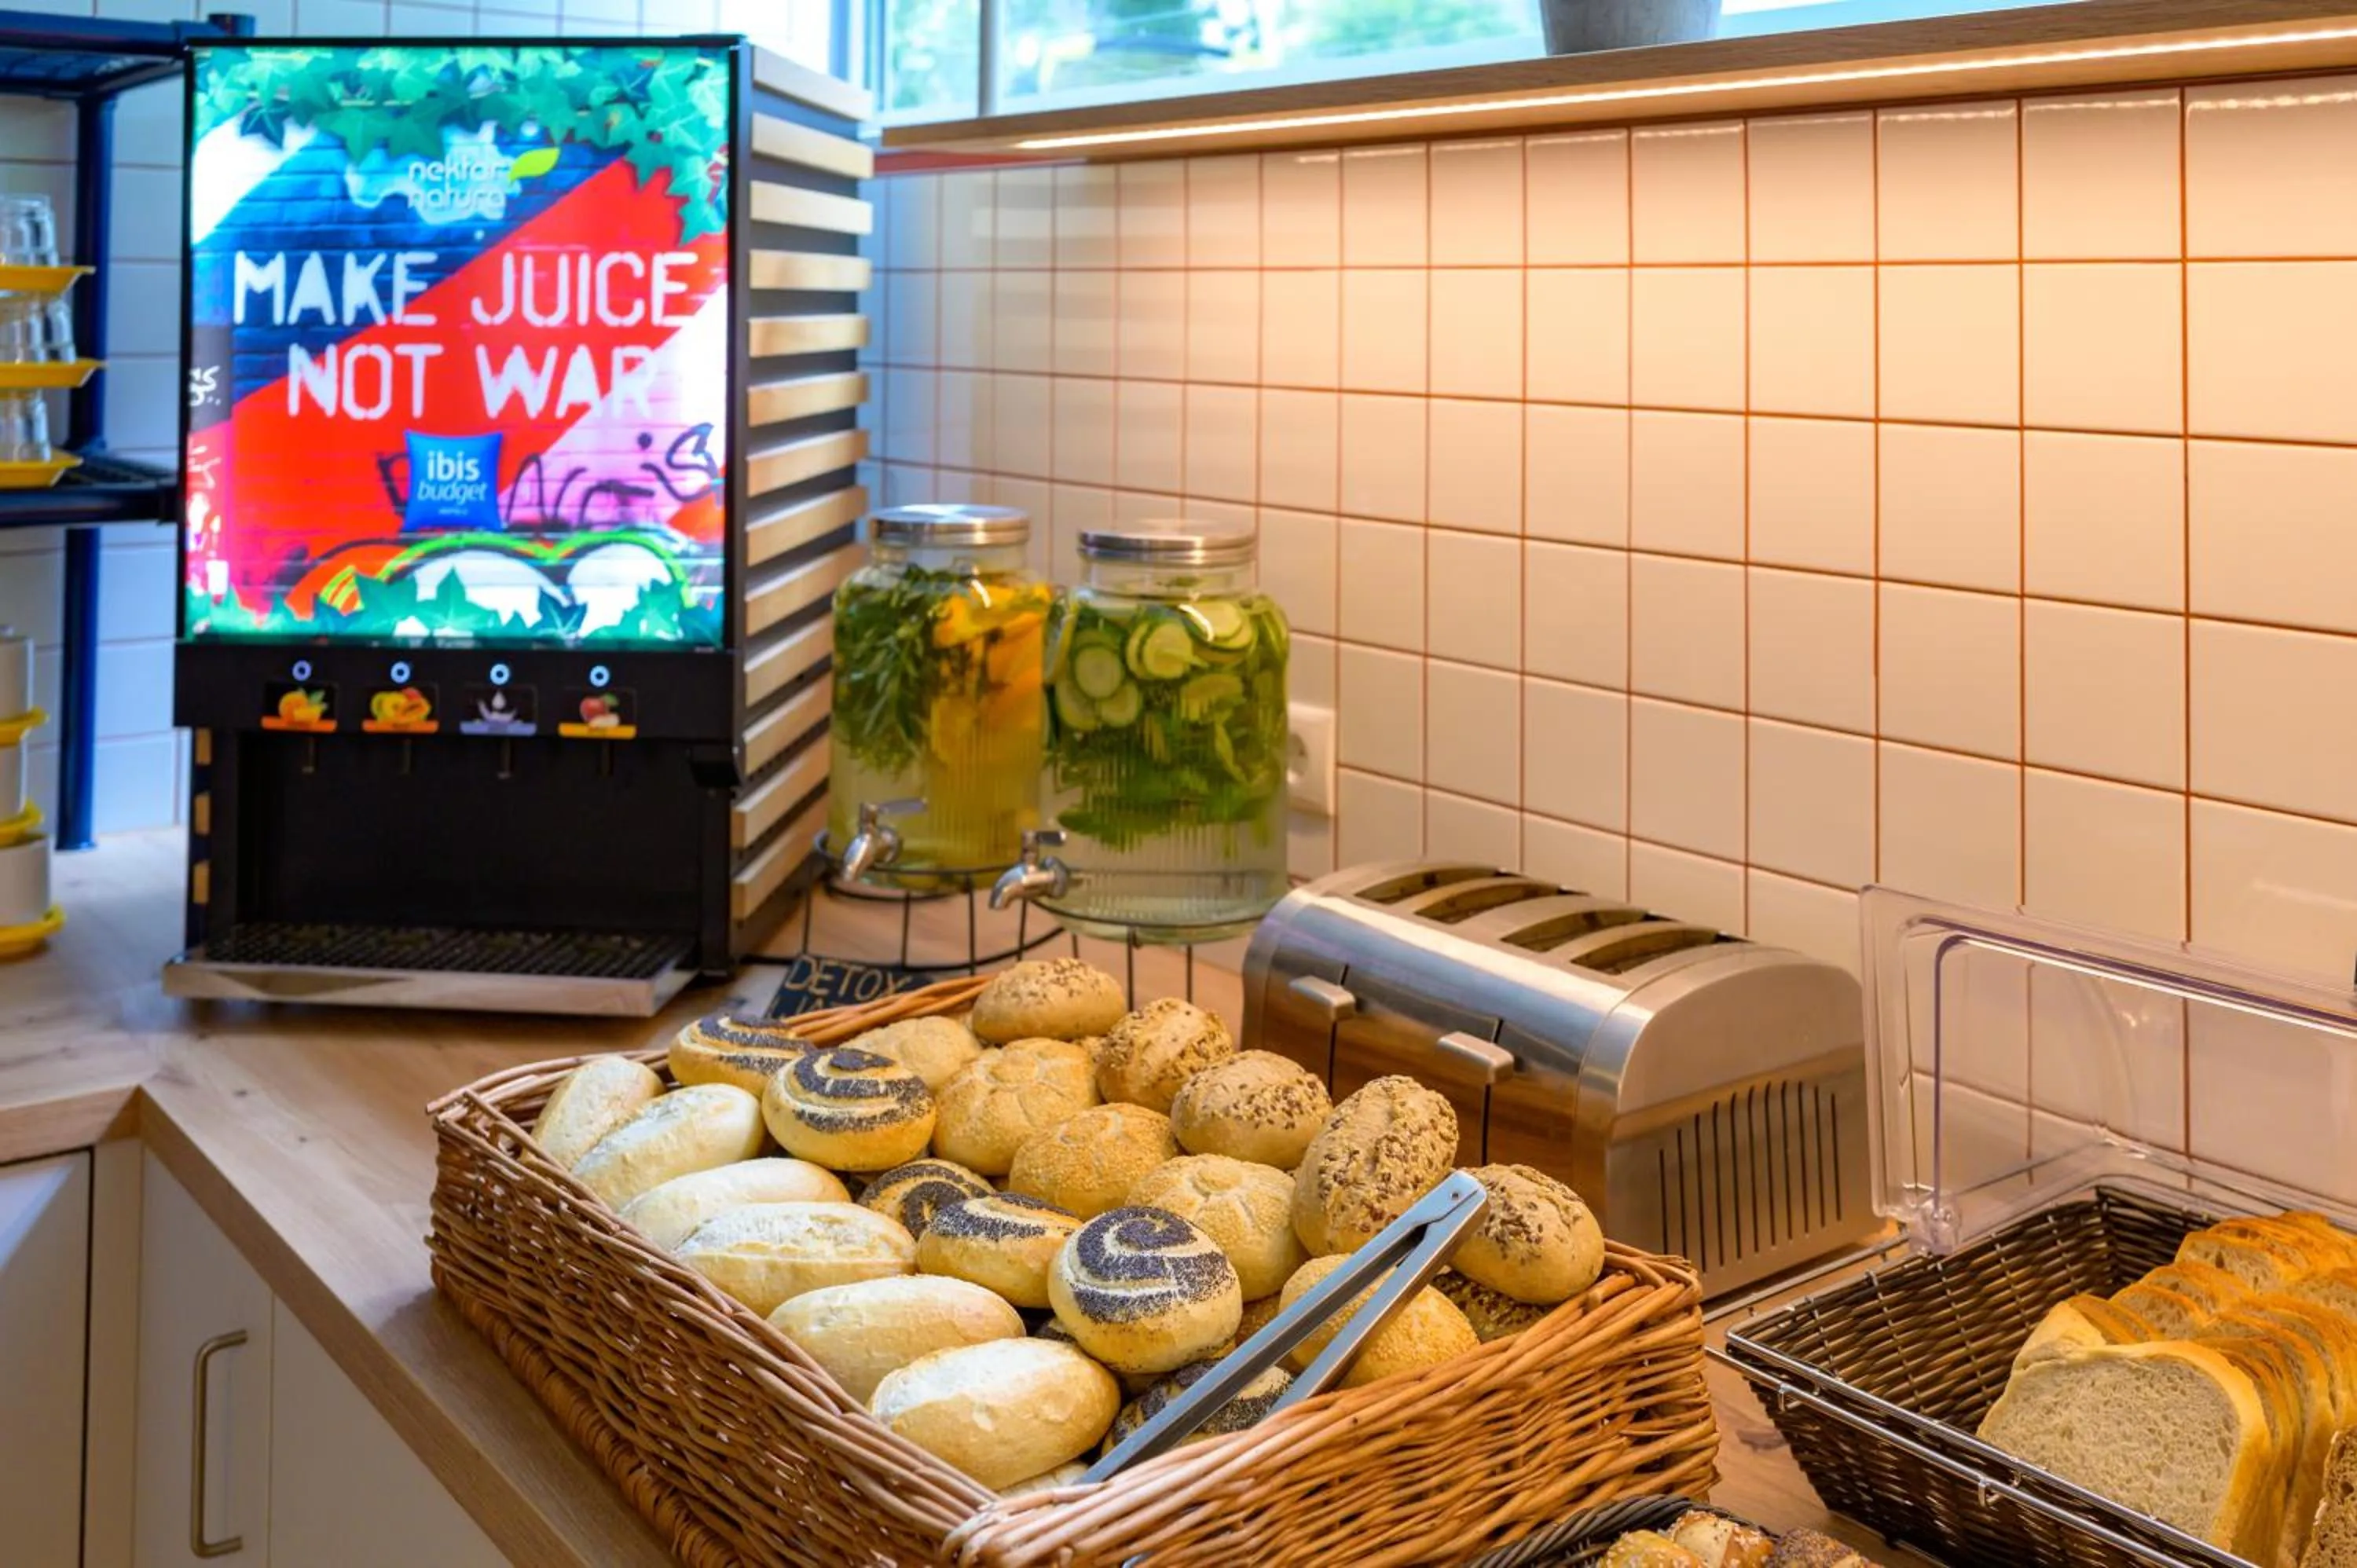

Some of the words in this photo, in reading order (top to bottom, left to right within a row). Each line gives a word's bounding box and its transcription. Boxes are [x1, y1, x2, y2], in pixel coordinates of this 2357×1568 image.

[233, 251, 439, 325] MAKE
[470, 251, 698, 327] JUICE
[287, 343, 444, 419] NOT
[475, 344, 659, 419] WAR
[427, 451, 481, 482] ibis
[417, 481, 488, 505] budget
[785, 954, 913, 1002] DETOX
